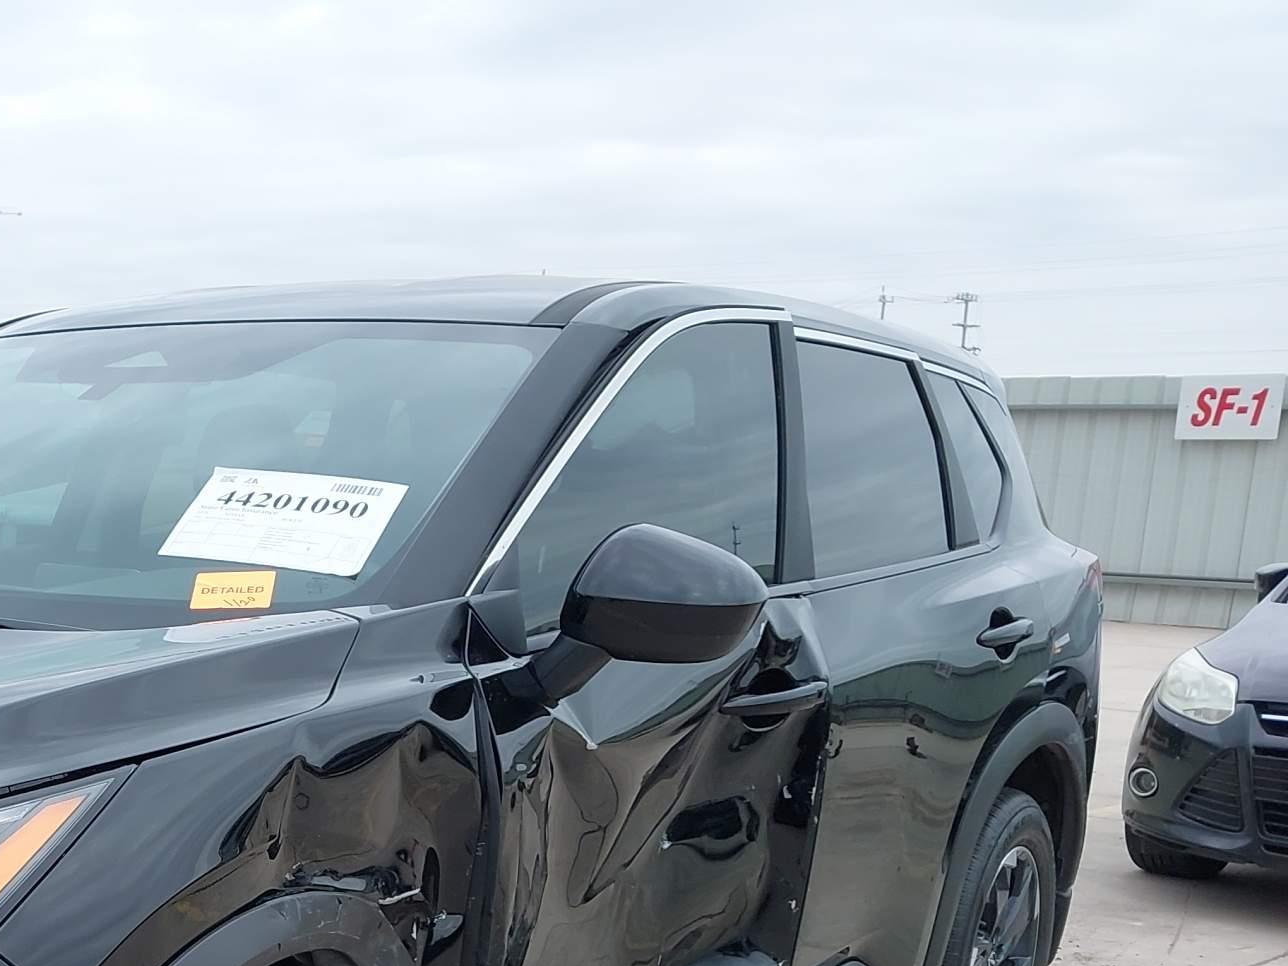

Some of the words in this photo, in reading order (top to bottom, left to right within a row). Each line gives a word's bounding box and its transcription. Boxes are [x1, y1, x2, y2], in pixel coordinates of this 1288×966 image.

[1190, 386, 1270, 427] SF-1
[217, 490, 369, 518] 44201090
[200, 585, 265, 595] DETAILED
